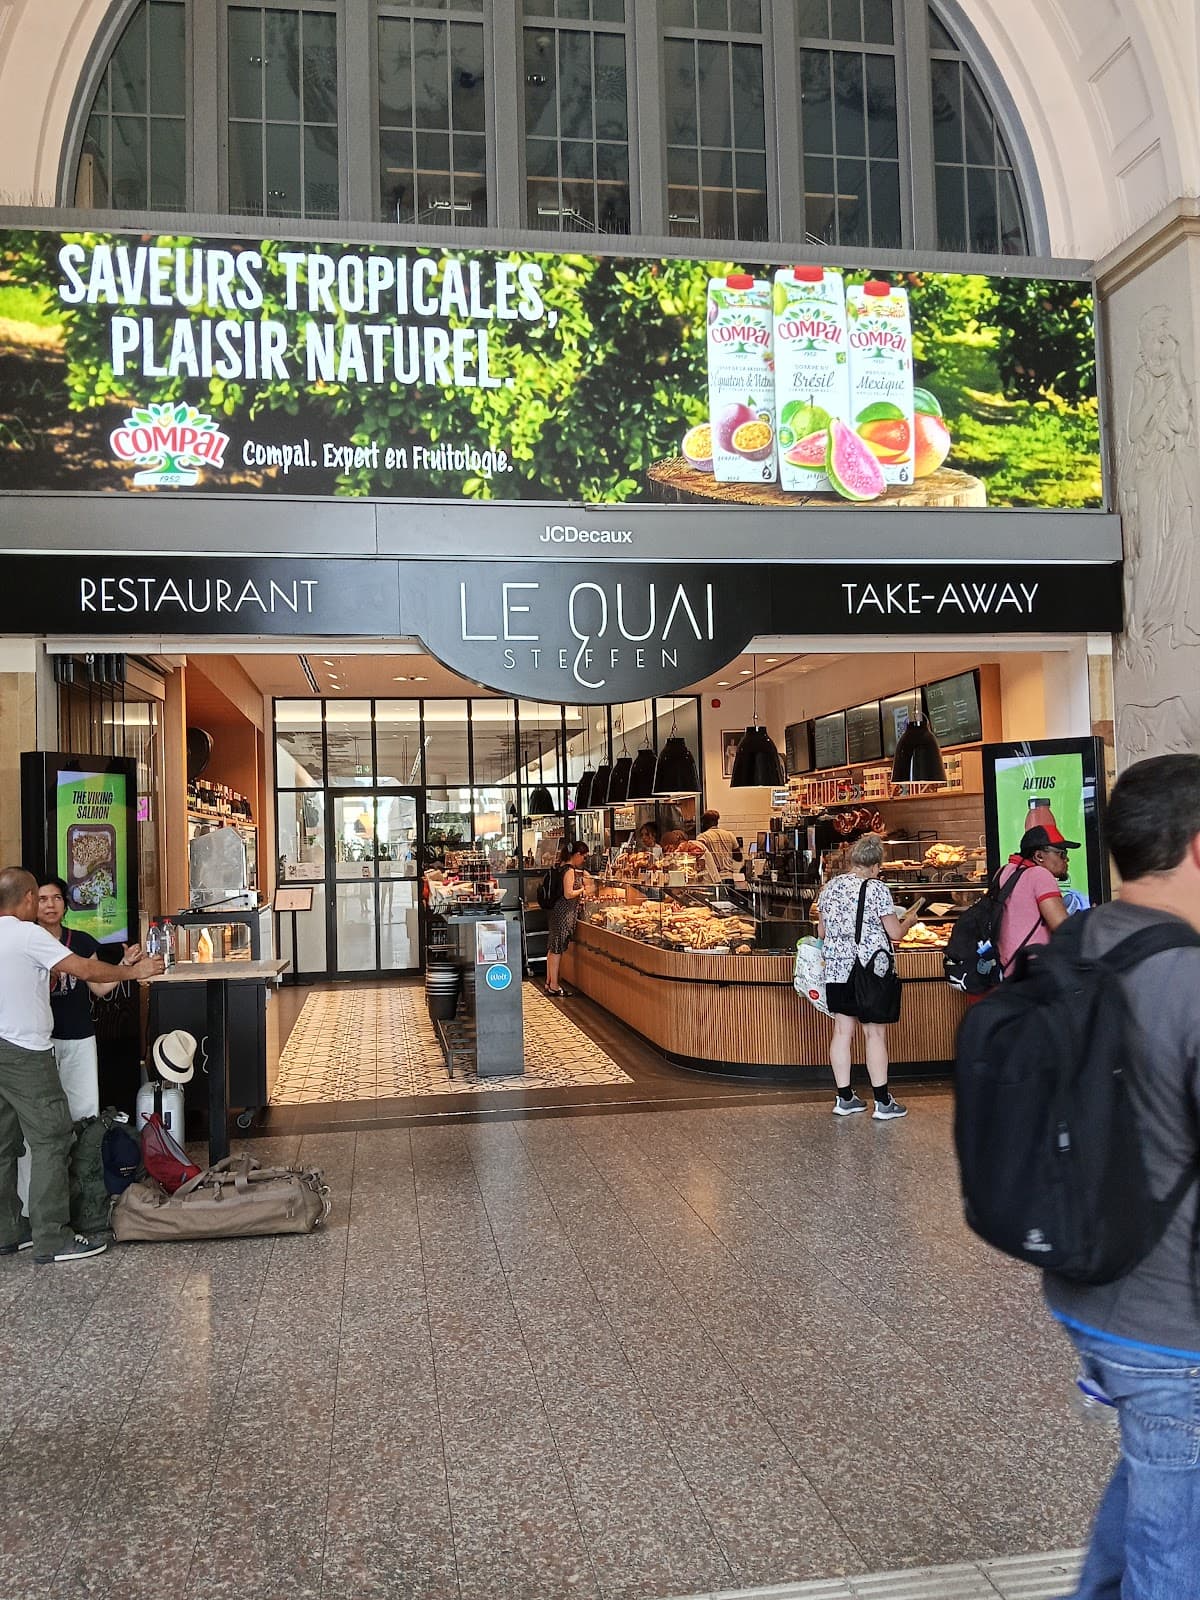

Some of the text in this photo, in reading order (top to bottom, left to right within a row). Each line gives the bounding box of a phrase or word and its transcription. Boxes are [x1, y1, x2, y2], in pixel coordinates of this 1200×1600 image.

[58, 244, 558, 329] SAVEURS TROPICALES,
[111, 316, 515, 388] PLAISIR NATUREL.
[792, 371, 835, 388] Brésil
[855, 375, 905, 397] Mexique
[242, 438, 514, 480] Compal. Expert en Fruitologie.
[159, 475, 181, 483] 1952
[539, 525, 633, 544] JCDecaux
[80, 577, 319, 613] RESTAURANT
[841, 583, 1039, 614] TAKE-AWAY
[460, 582, 714, 688] LE QUAI
[503, 648, 678, 669] STEFFEN
[72, 790, 113, 806] THE VIKING
[76, 805, 110, 820] SALMON
